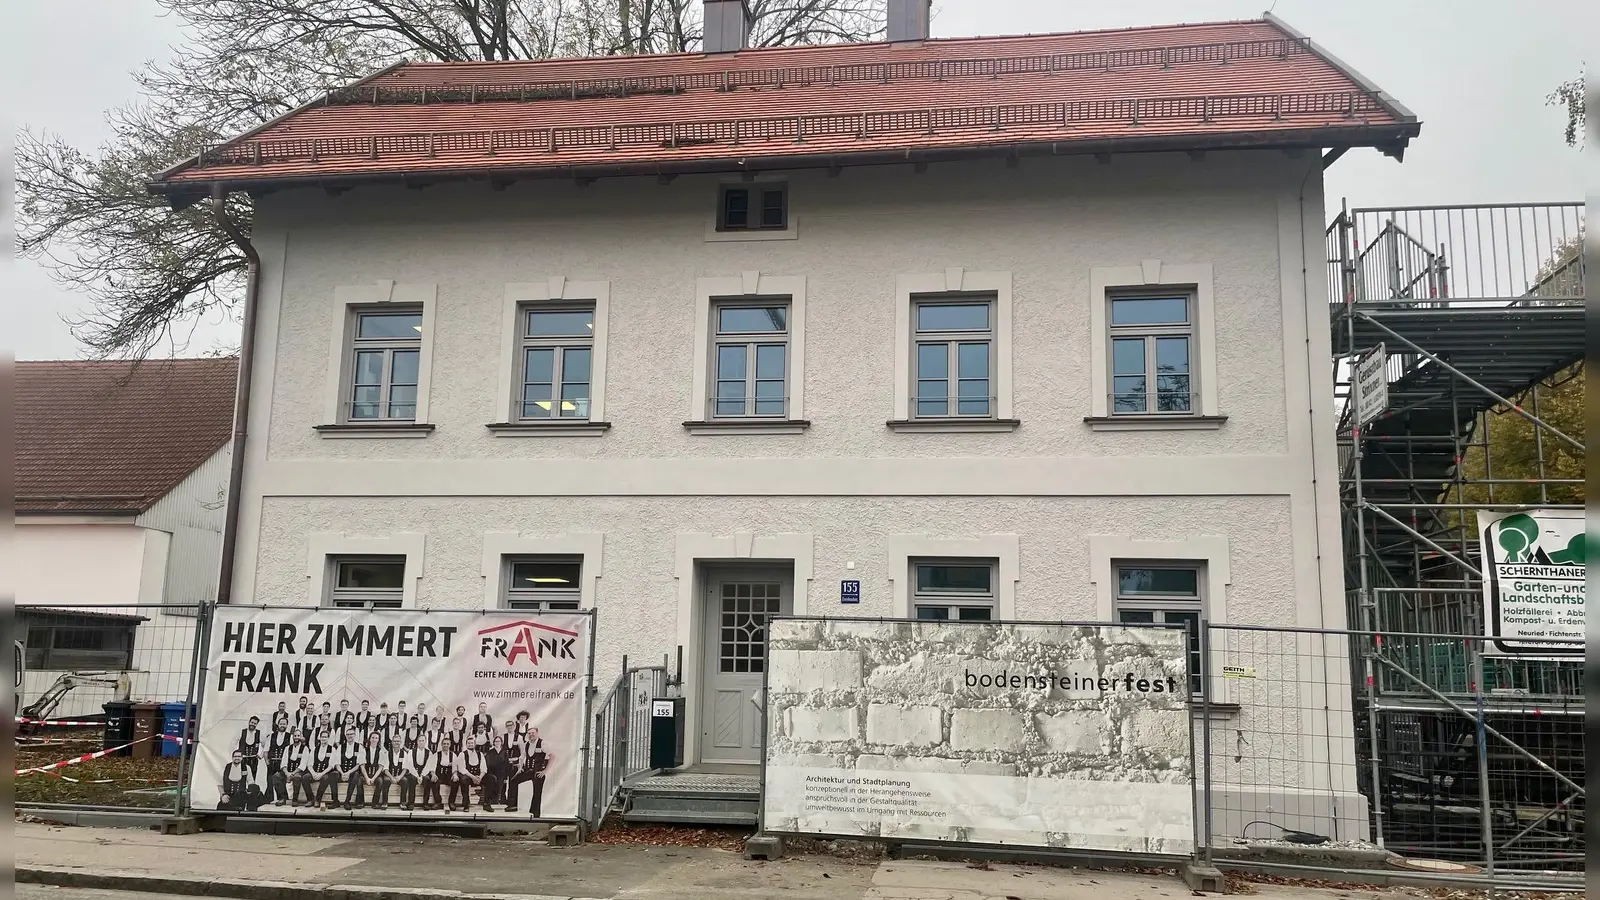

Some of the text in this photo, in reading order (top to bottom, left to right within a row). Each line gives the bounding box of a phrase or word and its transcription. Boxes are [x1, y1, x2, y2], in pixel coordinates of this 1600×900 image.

[1500, 566, 1586, 577] SCHERNTHANER
[842, 582, 858, 593] 155
[1503, 607, 1553, 616] Holzfällerei
[1503, 616, 1545, 625] Kompost-
[222, 622, 458, 658] HIER ZIMMERT
[480, 627, 576, 666] FRANK
[217, 660, 325, 695] FRANK
[474, 670, 577, 680] ECHTE MÜNCHNER ZIMMERER
[965, 668, 1177, 693] bodensteinerfest
[473, 688, 575, 700] www.zimmereifrank.de
[656, 708, 670, 716] 155
[805, 775, 911, 789] Architektur und Stadtplanung
[805, 784, 848, 794] konzeptionell
[857, 787, 868, 795] der
[870, 787, 931, 798] Herangehensweise
[805, 794, 848, 803] anspruchsvoll
[857, 796, 868, 804] der
[870, 797, 917, 807] Gestaltqualität
[805, 804, 855, 813] umweltbewusst
[866, 807, 895, 817] Umgang
[896, 808, 908, 816] mit
[909, 809, 947, 818] Ressourcen
